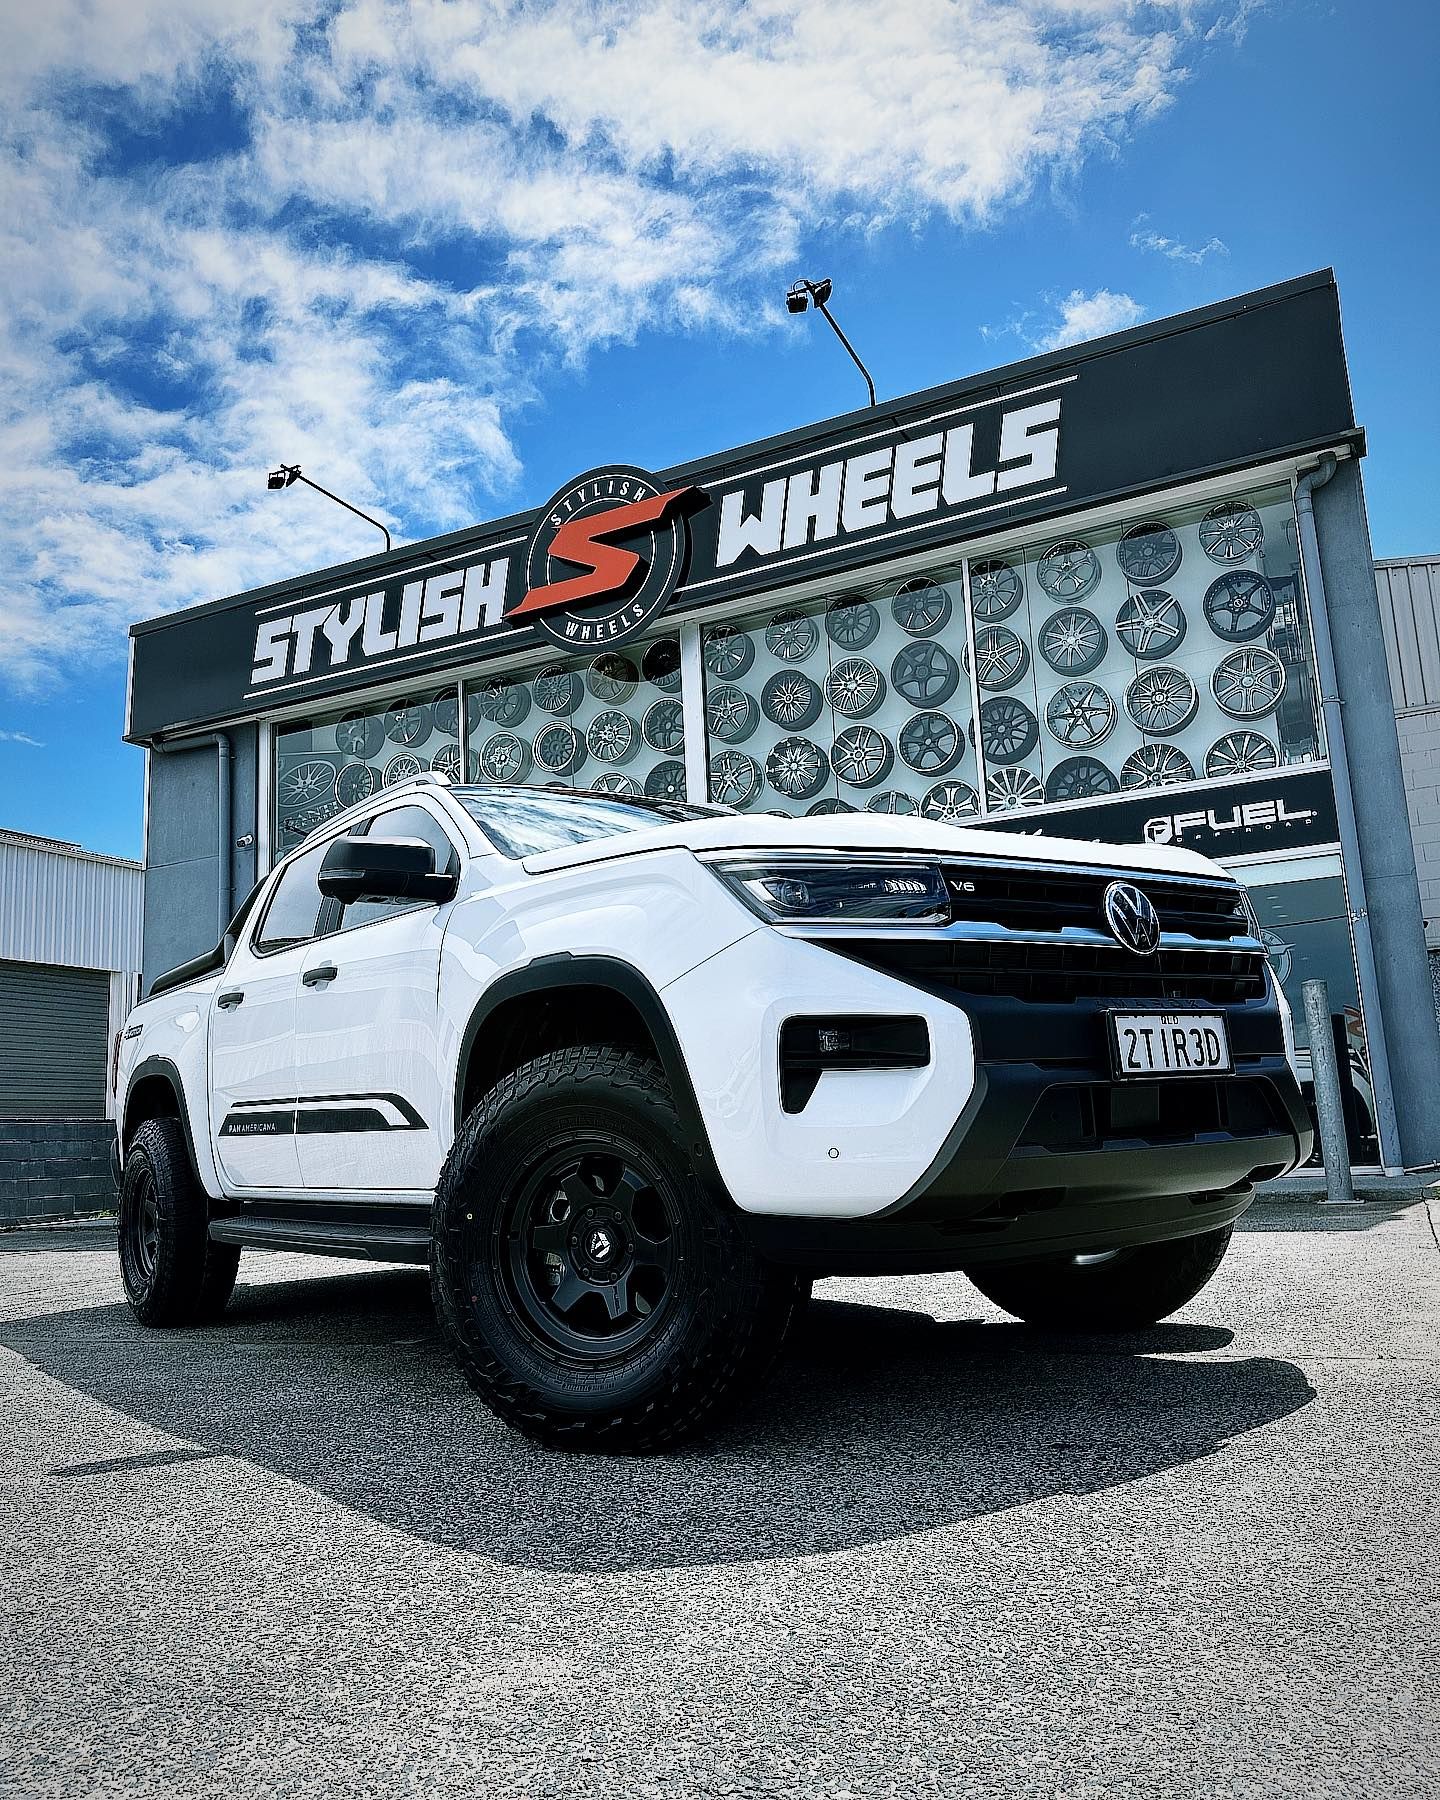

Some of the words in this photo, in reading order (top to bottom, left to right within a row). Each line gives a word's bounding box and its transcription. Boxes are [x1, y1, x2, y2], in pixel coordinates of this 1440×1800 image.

[551, 480, 647, 526] STYLISH
[251, 557, 510, 684] STYLISH
[715, 398, 1062, 568] WHEELS
[504, 485, 695, 617] S
[565, 603, 644, 640] WHEELS
[1173, 799, 1312, 836] FUEL
[950, 880, 975, 892] V6
